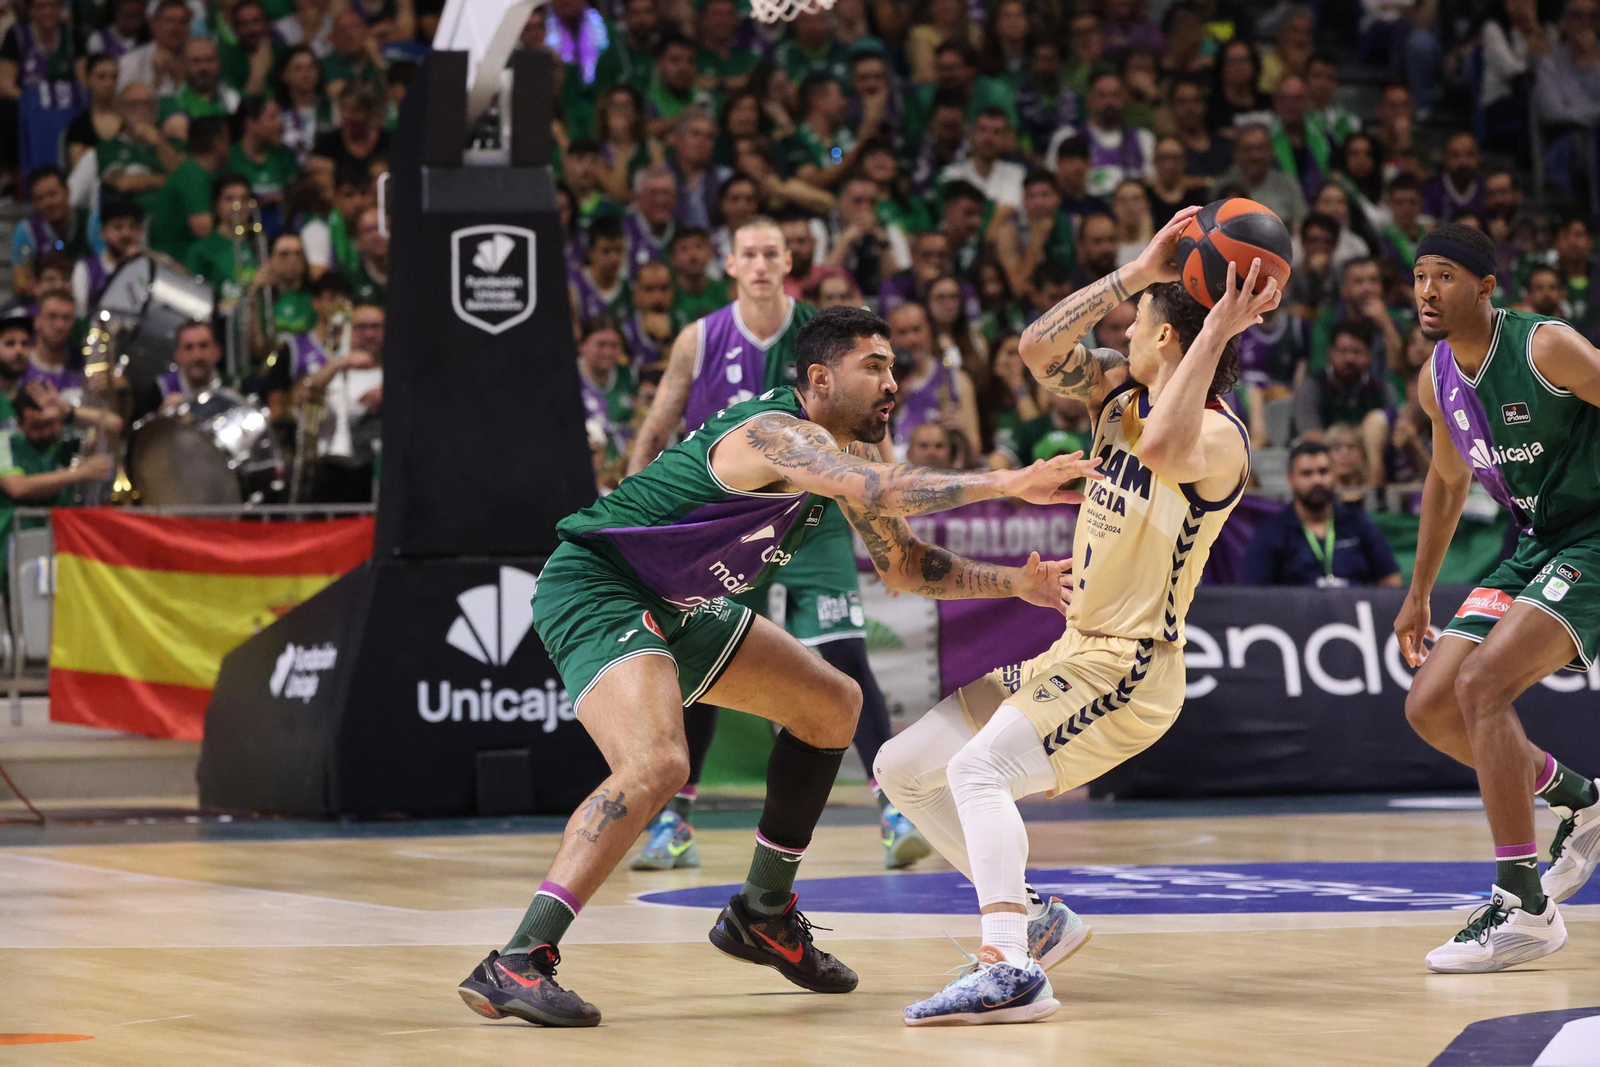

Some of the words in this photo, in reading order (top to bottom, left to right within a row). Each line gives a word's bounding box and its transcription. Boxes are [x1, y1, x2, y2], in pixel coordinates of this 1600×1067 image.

[1104, 523, 1122, 534] 2024
[1559, 567, 1574, 579] acb
[1051, 677, 1065, 689] acb
[417, 678, 577, 733] Unicaja
